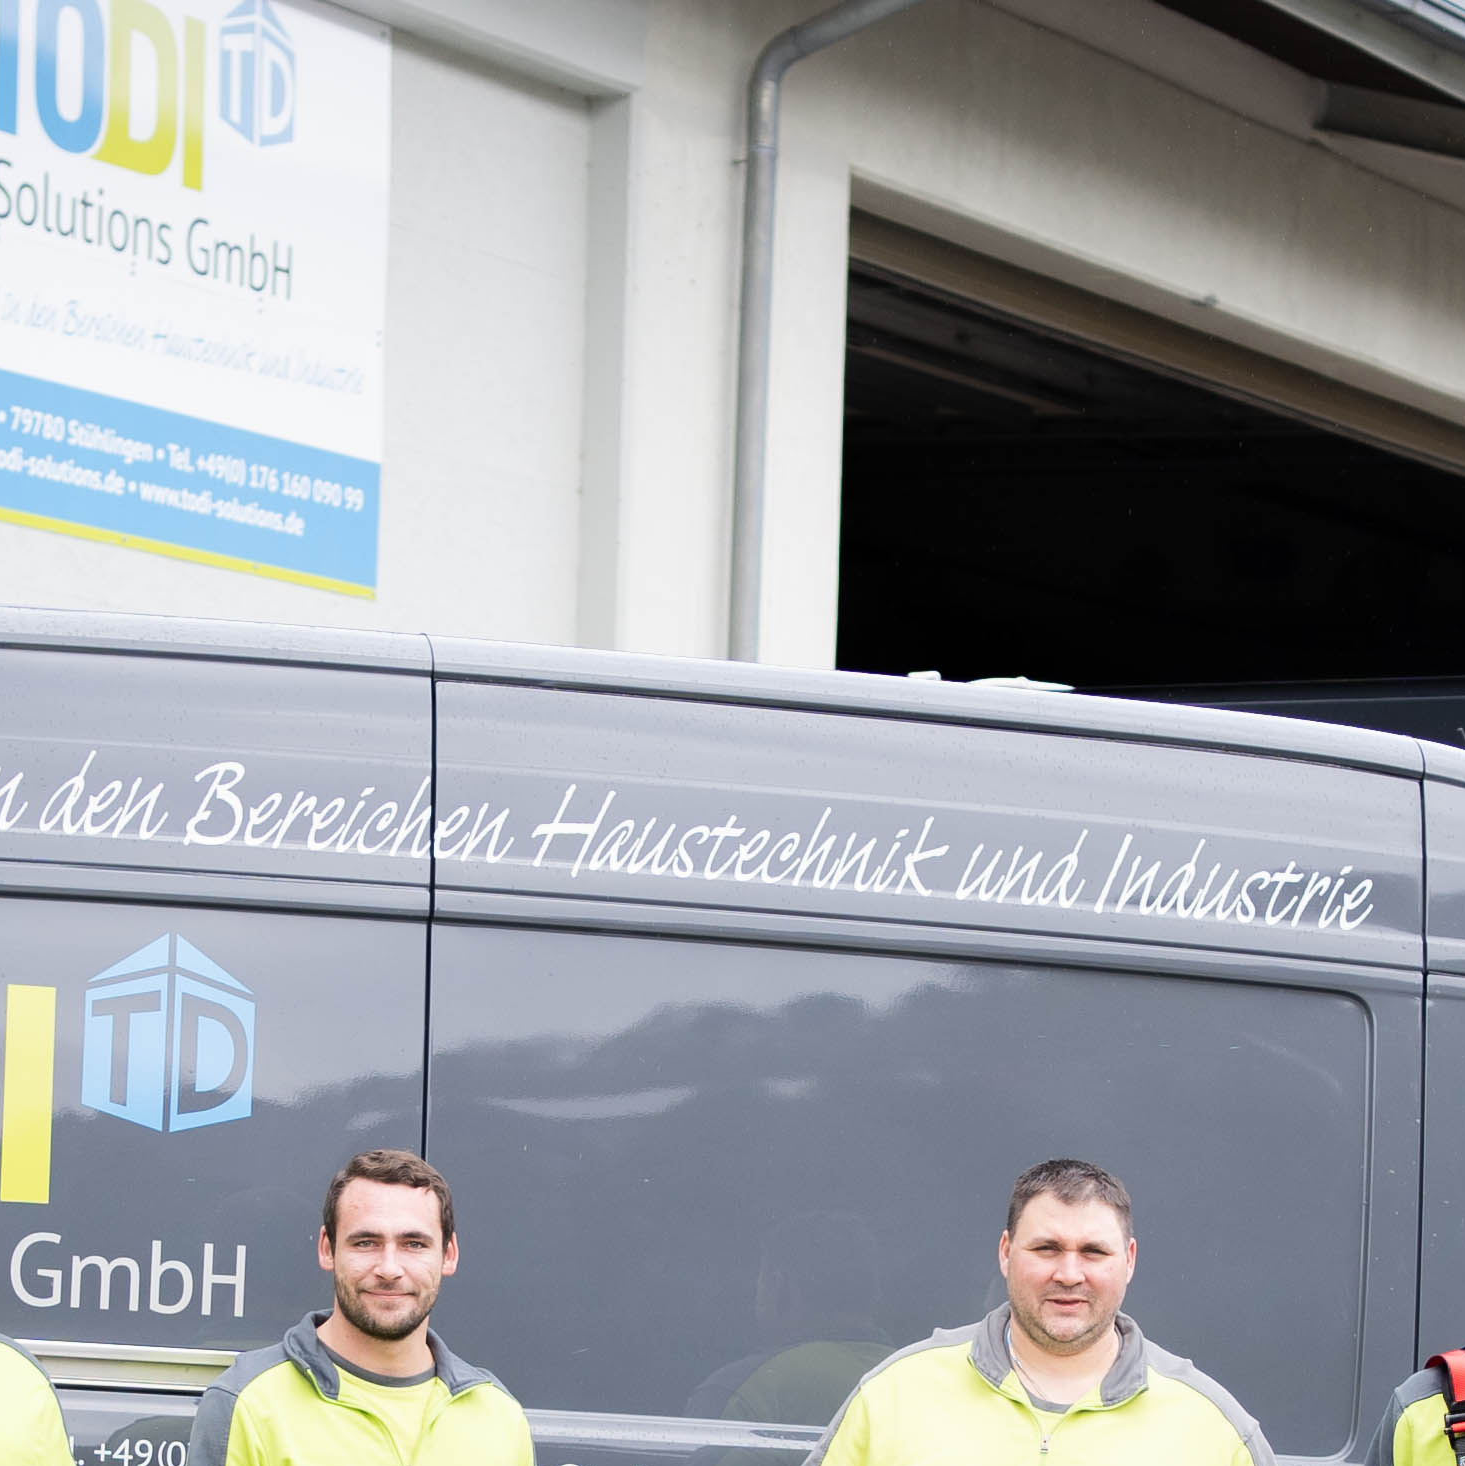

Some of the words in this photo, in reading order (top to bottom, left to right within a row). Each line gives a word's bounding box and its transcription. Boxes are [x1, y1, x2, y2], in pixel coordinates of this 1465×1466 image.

[187, 216, 293, 300] GmbH
[10, 405, 66, 442] 79780
[67, 419, 153, 464] Stühlingen
[196, 453, 247, 487] +49(0)
[249, 463, 279, 493] 176
[281, 471, 311, 500] 160
[312, 478, 343, 509] 090
[344, 486, 365, 512] 99
[139, 481, 305, 537] www.todi-solutions.de
[38, 749, 167, 842] den
[182, 760, 513, 864] Bereichen
[531, 783, 947, 898] Haustechnik
[957, 830, 1085, 914] und
[1093, 832, 1374, 931] Industrie
[11, 1232, 247, 1318] GmbH
